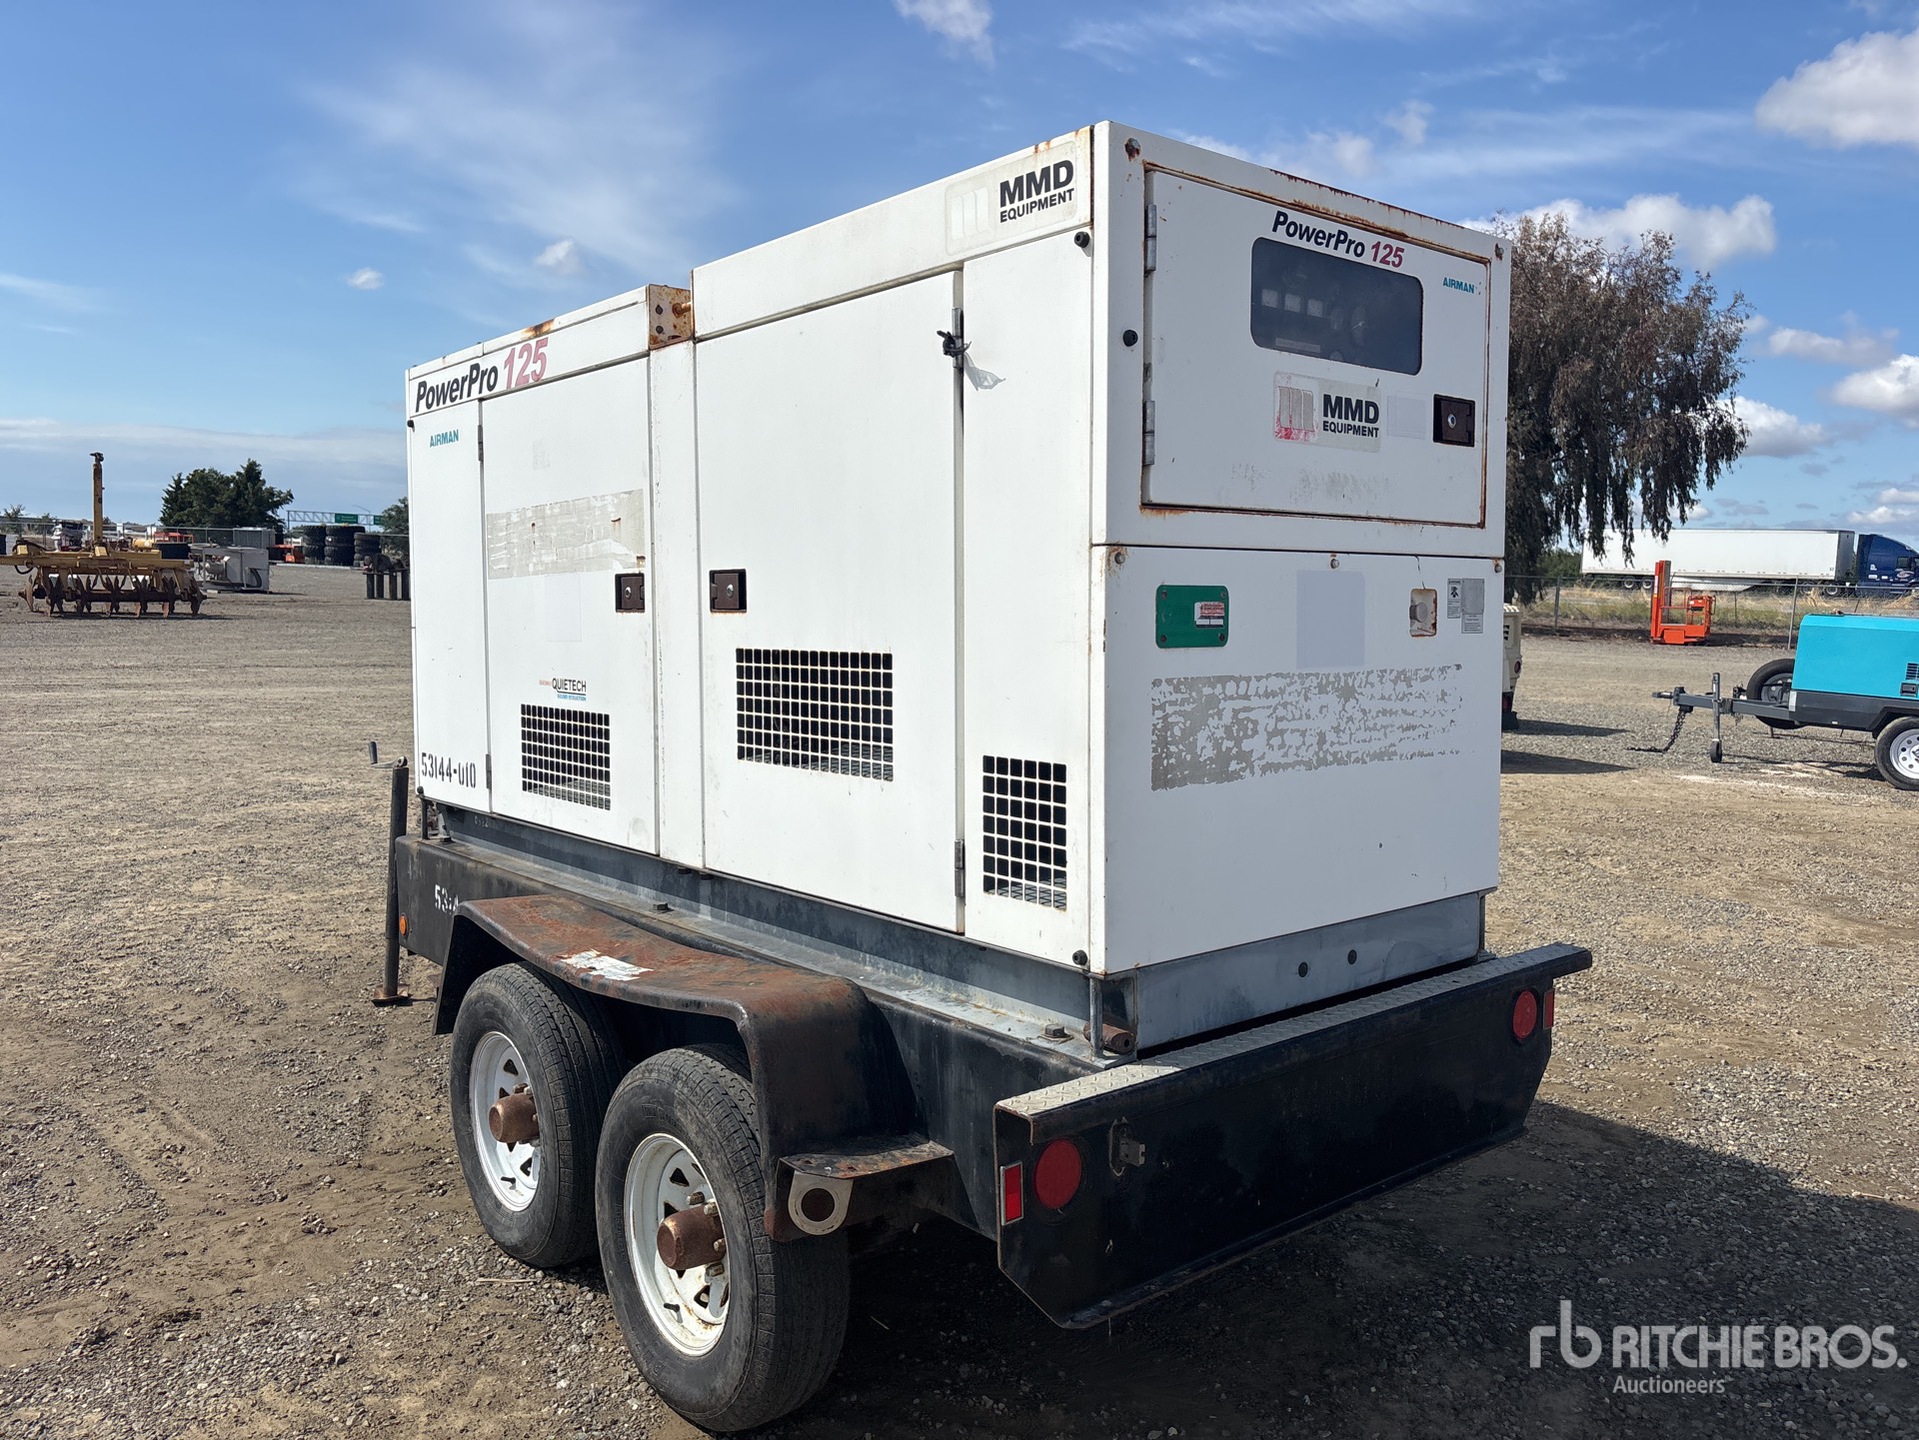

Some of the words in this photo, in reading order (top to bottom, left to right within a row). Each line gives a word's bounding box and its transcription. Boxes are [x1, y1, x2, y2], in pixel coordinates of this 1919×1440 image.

[1000, 159, 1074, 208] MMD
[1000, 188, 1075, 223] EQUIPMENT
[1271, 210, 1365, 258] PowerPro
[1370, 241, 1405, 268] 125
[1442, 277, 1475, 294] AIRMAN
[415, 362, 498, 413] PowerPro
[504, 337, 549, 390] 125
[1323, 393, 1380, 425] MMD
[429, 429, 459, 448] AIRMAN
[1322, 420, 1380, 438] EQUIPMENT
[551, 677, 587, 693] QUIETECH
